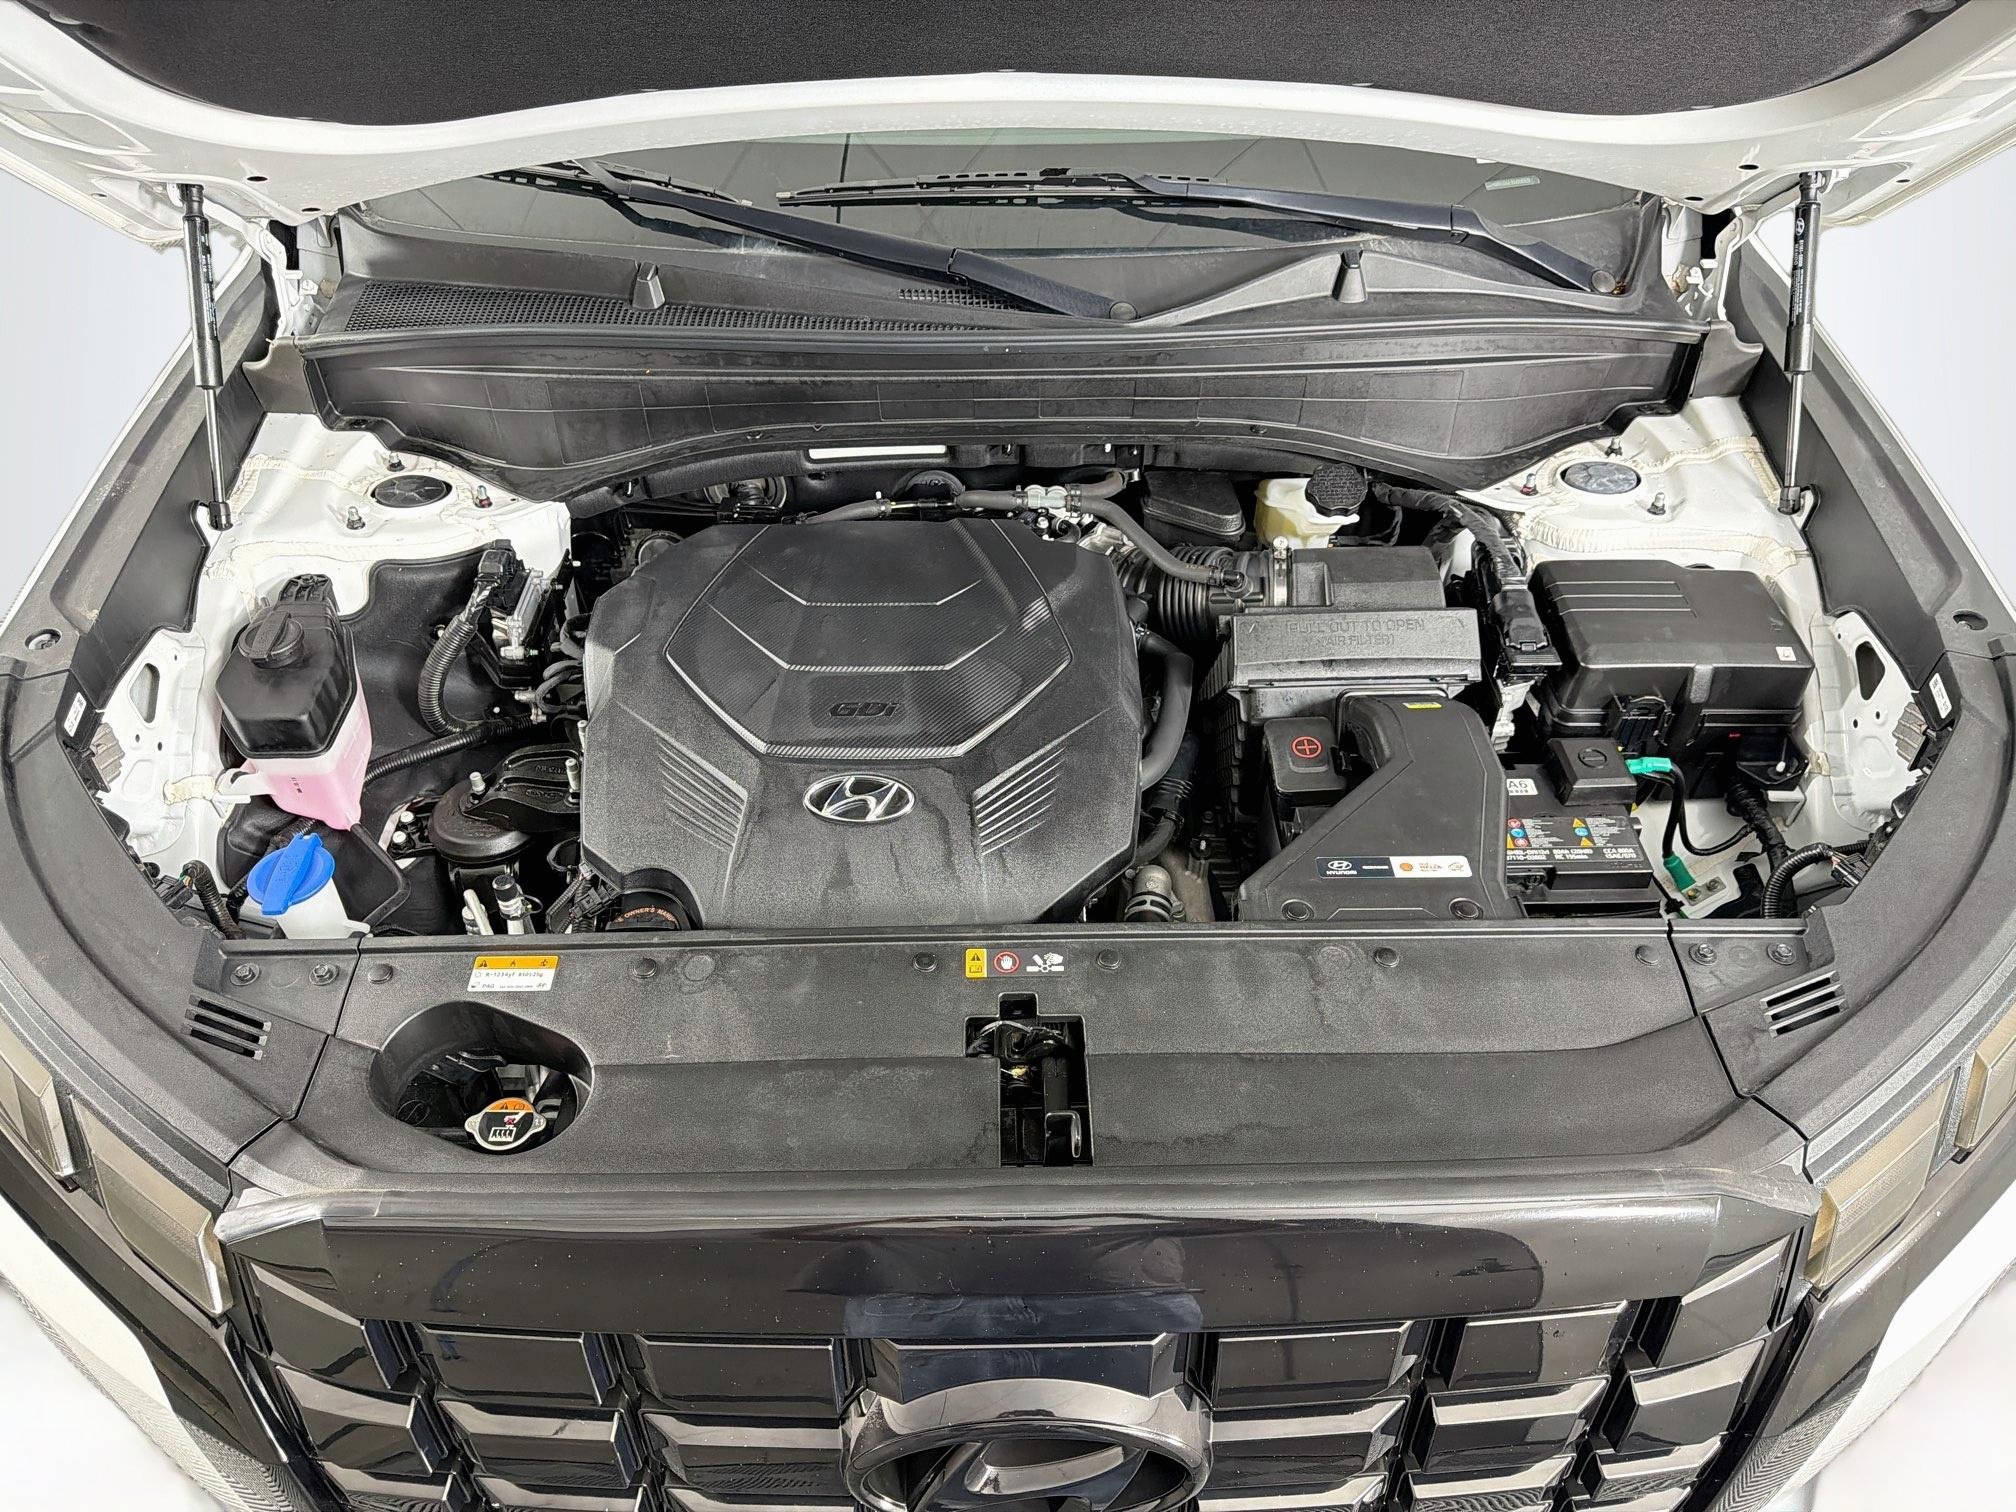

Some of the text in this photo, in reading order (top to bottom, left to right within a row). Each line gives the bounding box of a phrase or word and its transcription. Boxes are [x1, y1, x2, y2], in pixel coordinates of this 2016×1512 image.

[1329, 620, 1357, 633] OUT
[1361, 620, 1382, 632] TO
[1386, 618, 1424, 631] OPEN
